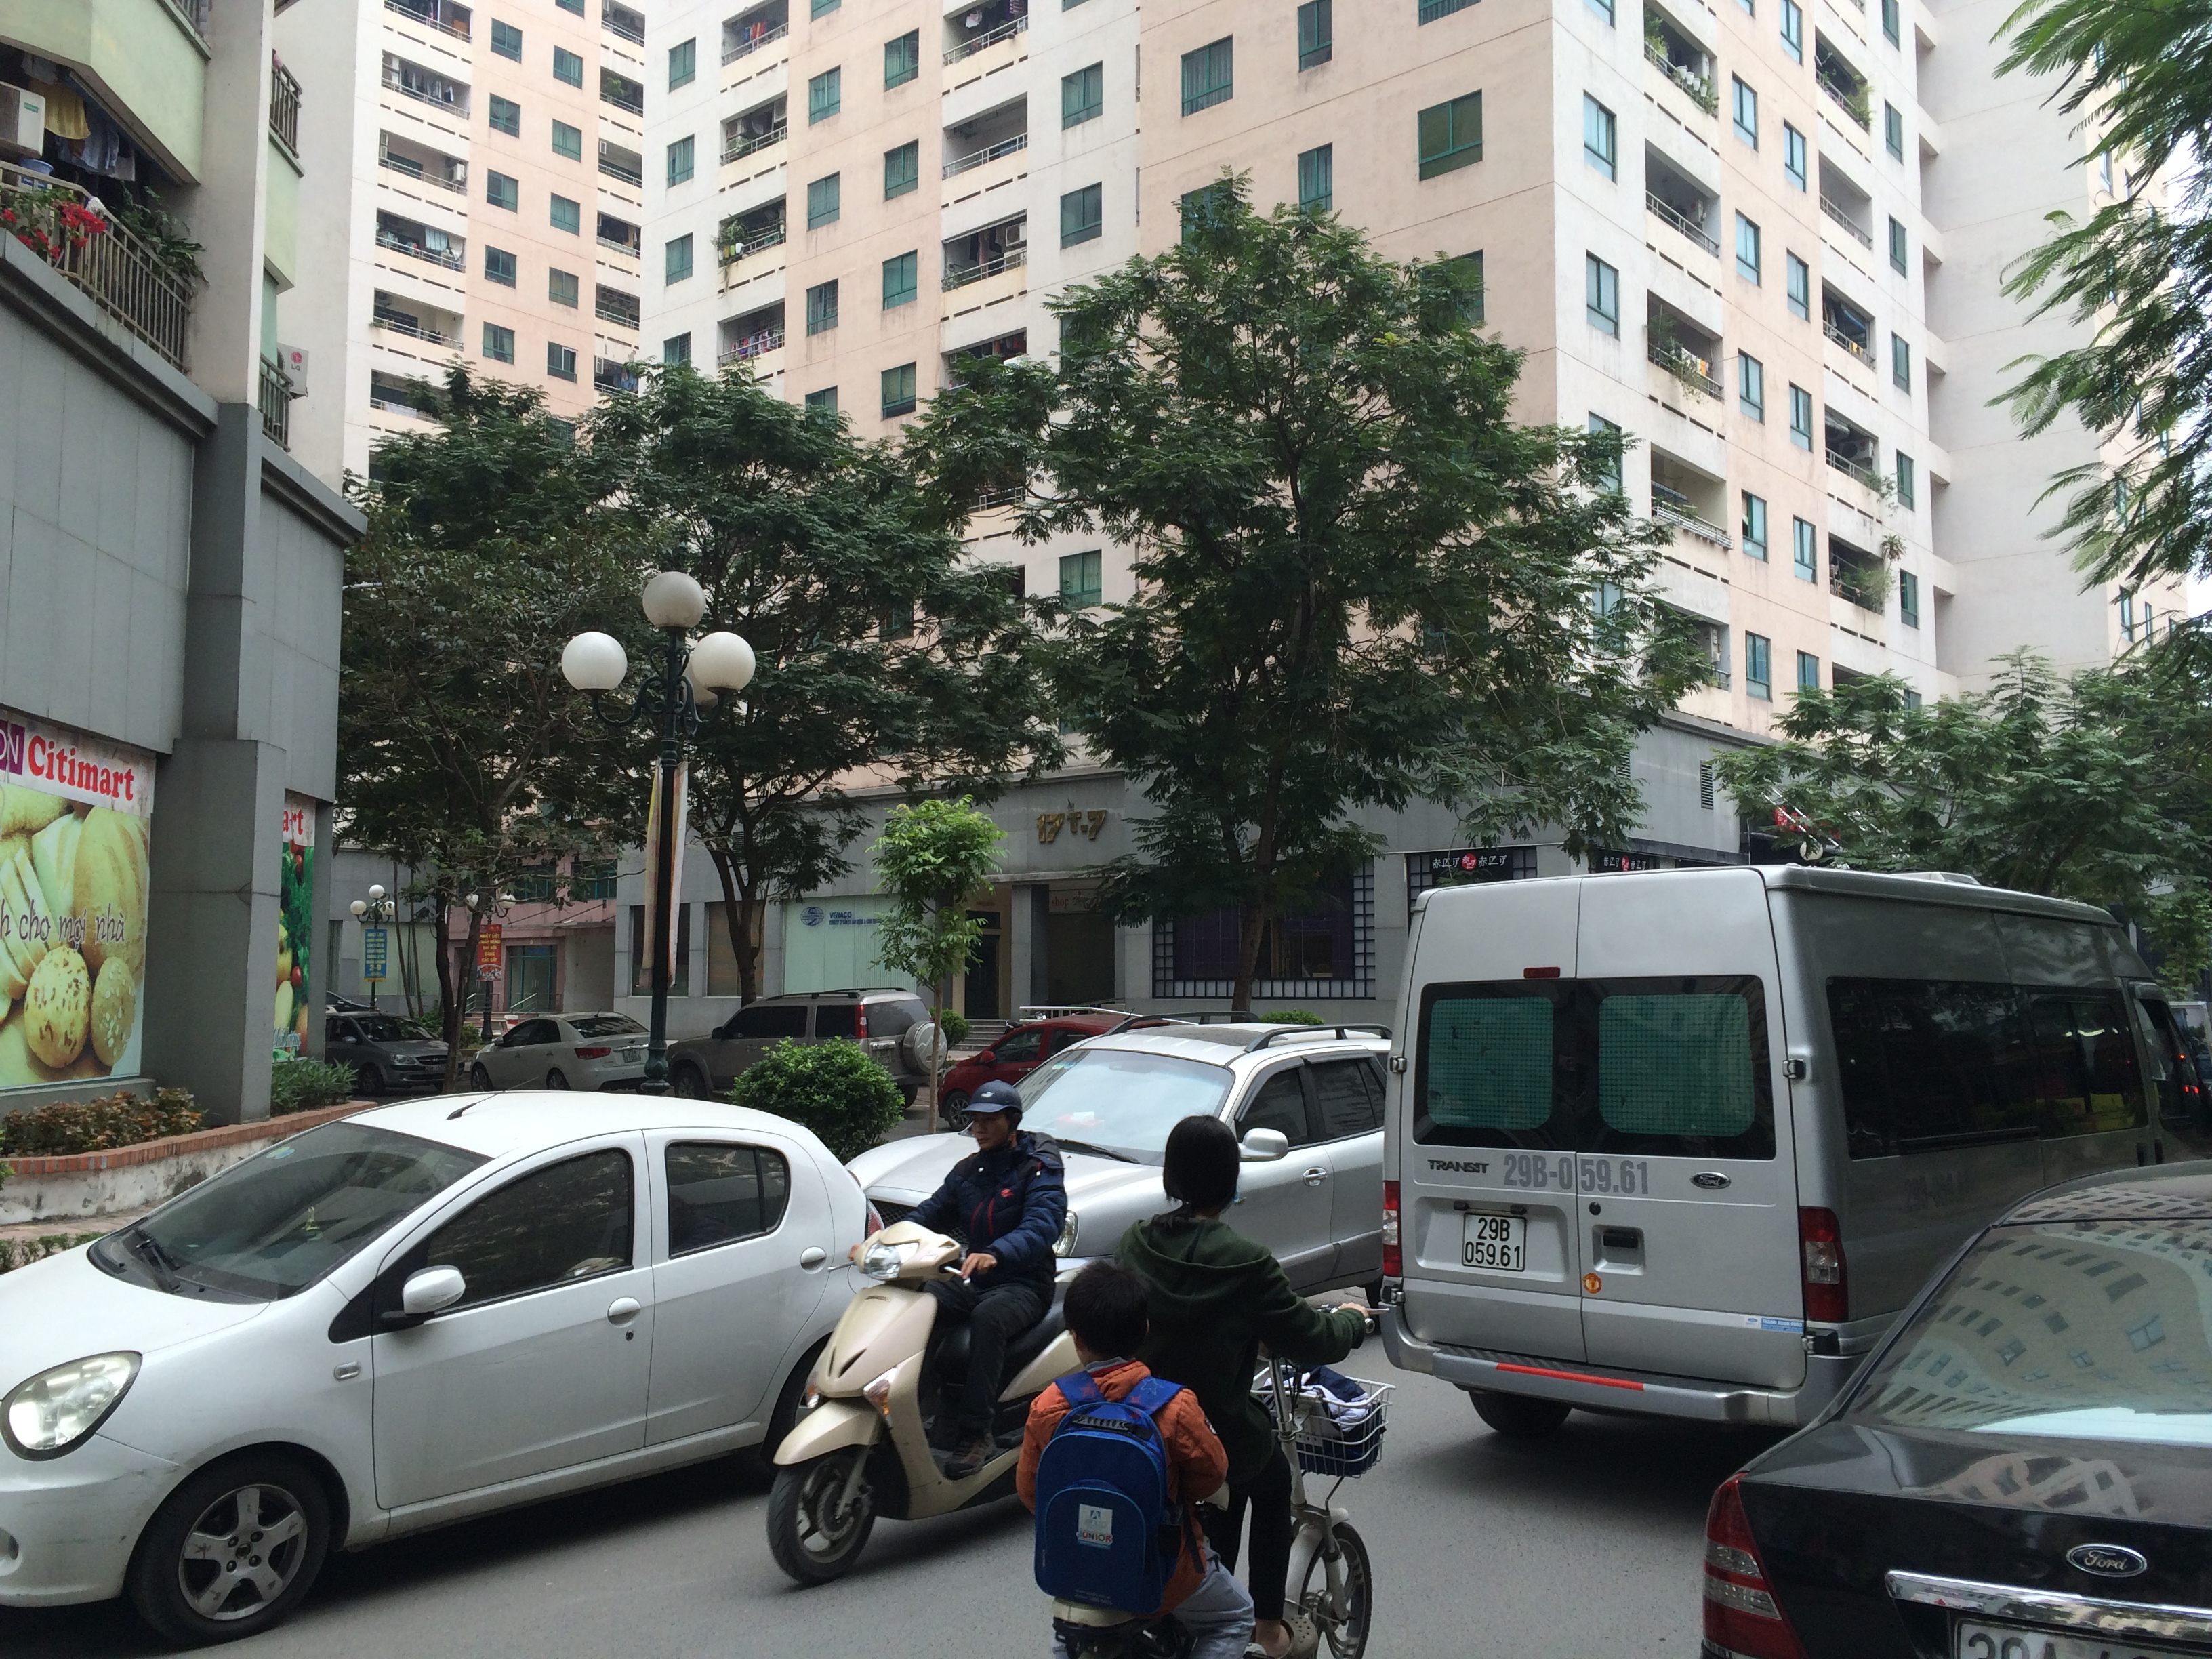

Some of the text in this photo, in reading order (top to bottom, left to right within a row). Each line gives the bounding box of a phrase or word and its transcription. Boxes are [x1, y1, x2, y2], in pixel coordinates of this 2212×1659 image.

[28, 735, 134, 801] Citimart
[1051, 896, 1069, 909] shop
[19, 899, 51, 942] cho
[59, 909, 87, 950] mọi
[96, 903, 125, 943] nhà
[1427, 1159, 1490, 1174] TRANSIT
[1477, 1218, 1511, 1242] 29B
[1465, 1242, 1521, 1268] 059.61
[2084, 1550, 2127, 1570] Ford
